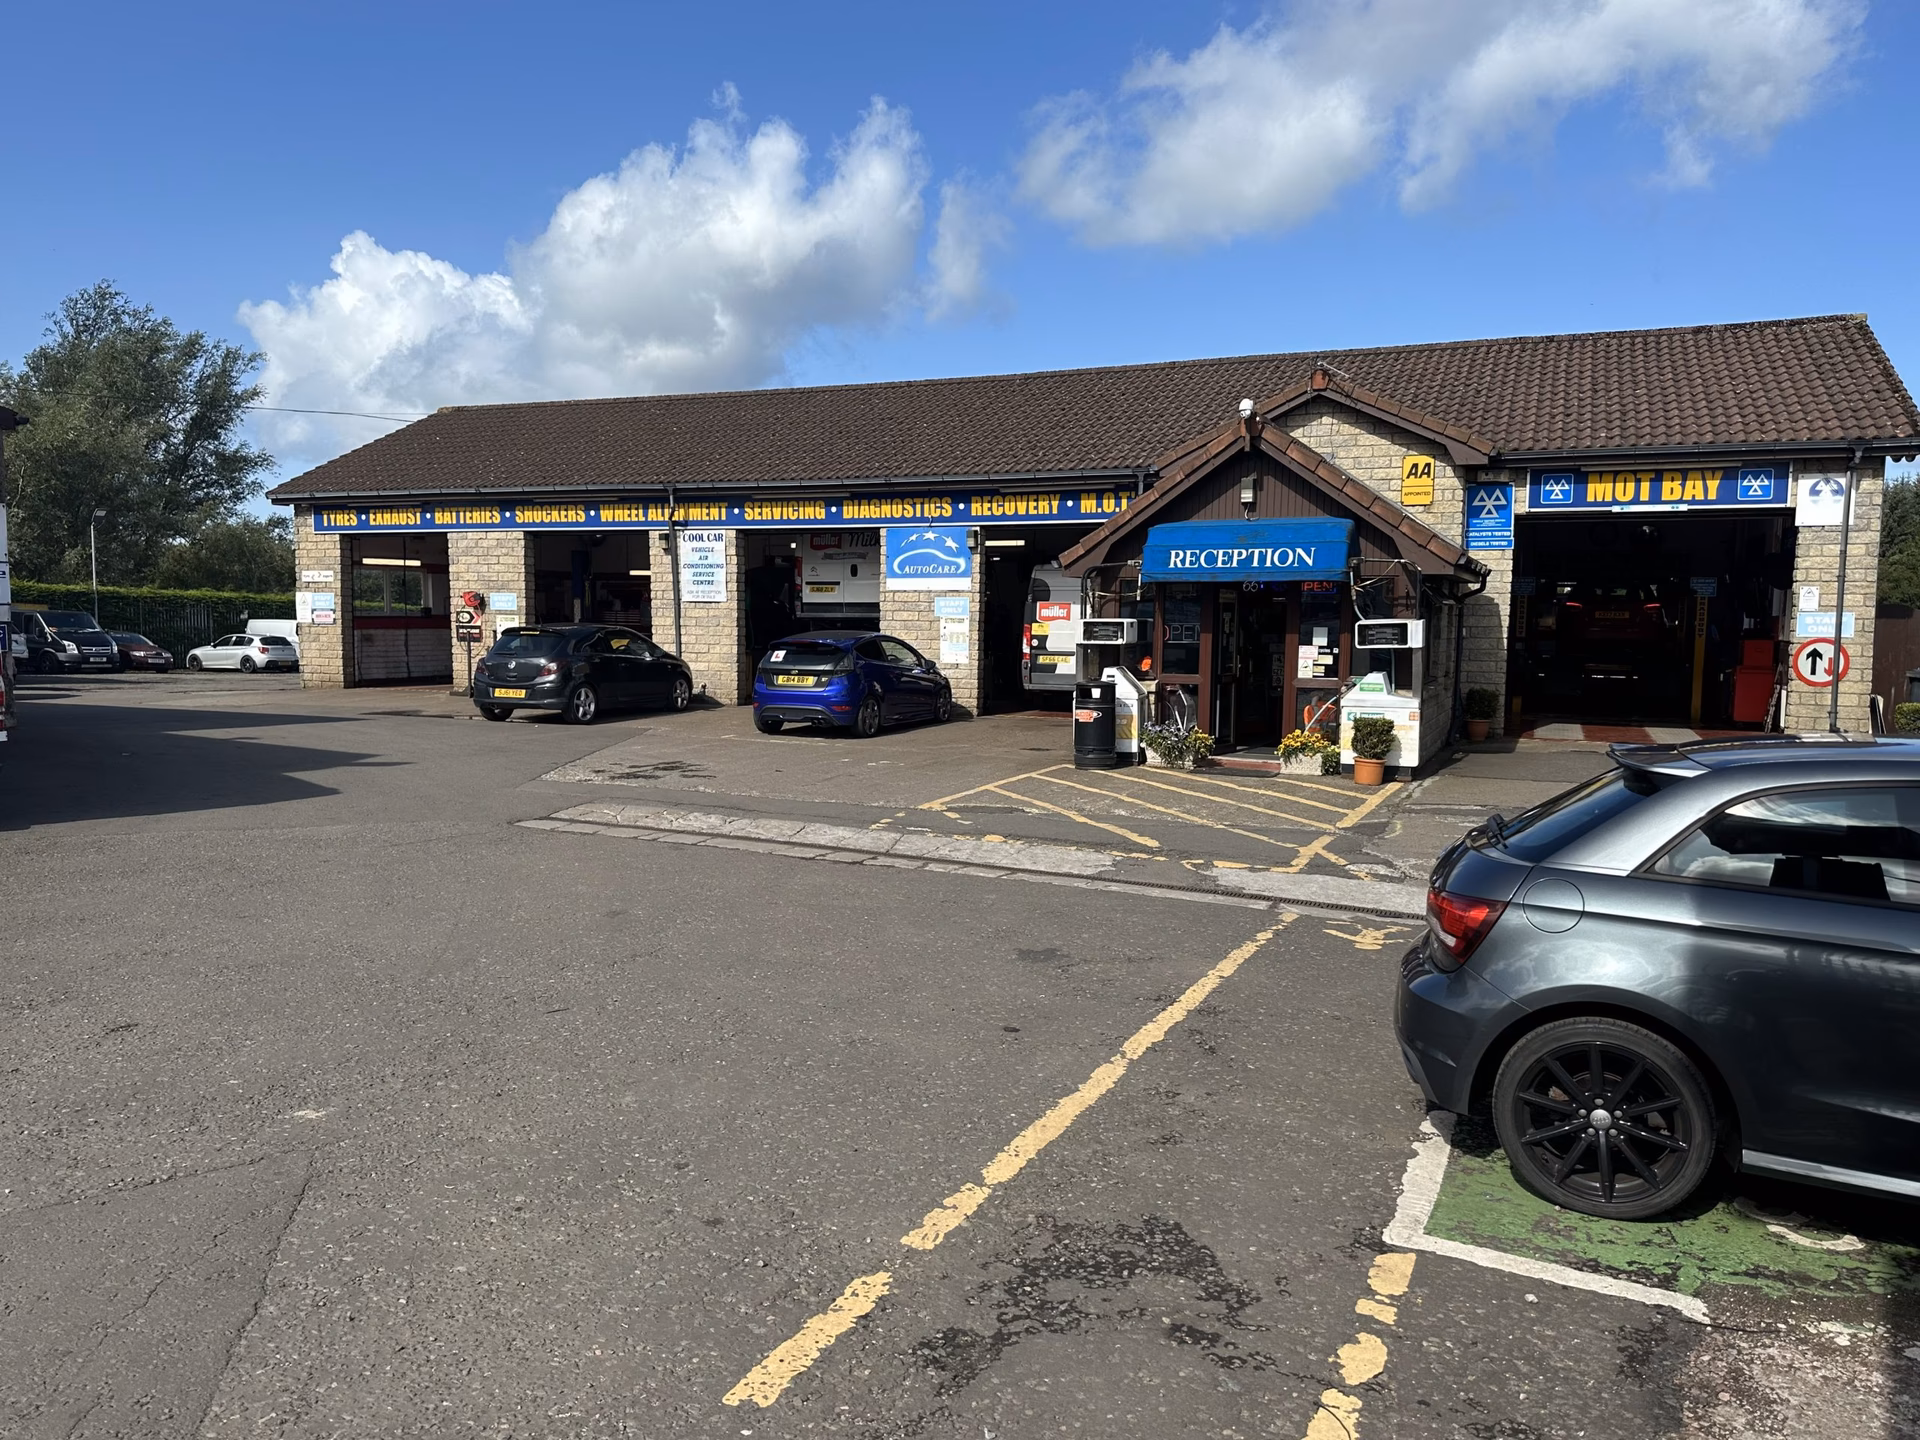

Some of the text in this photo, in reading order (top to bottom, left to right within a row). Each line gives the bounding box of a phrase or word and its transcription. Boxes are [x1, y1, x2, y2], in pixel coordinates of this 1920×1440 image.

[1406, 463, 1432, 479] AA
[1586, 470, 1724, 502] MOT BAY
[321, 509, 358, 526] TYRES
[369, 508, 422, 525] EXHAUST
[434, 506, 501, 525] BATTERIES
[515, 504, 586, 523] SHOCKERS
[600, 503, 645, 522] WHEEL
[744, 500, 826, 520] SERVICING
[842, 497, 953, 519] DIAGNOSTICS
[971, 494, 1061, 516] RECOVERY
[682, 532, 724, 542] COOL CAR
[1168, 547, 1316, 569] RECEPTION
[1301, 582, 1333, 592] PEN
[1040, 606, 1068, 617] müller
[1807, 625, 1835, 633] ONL
